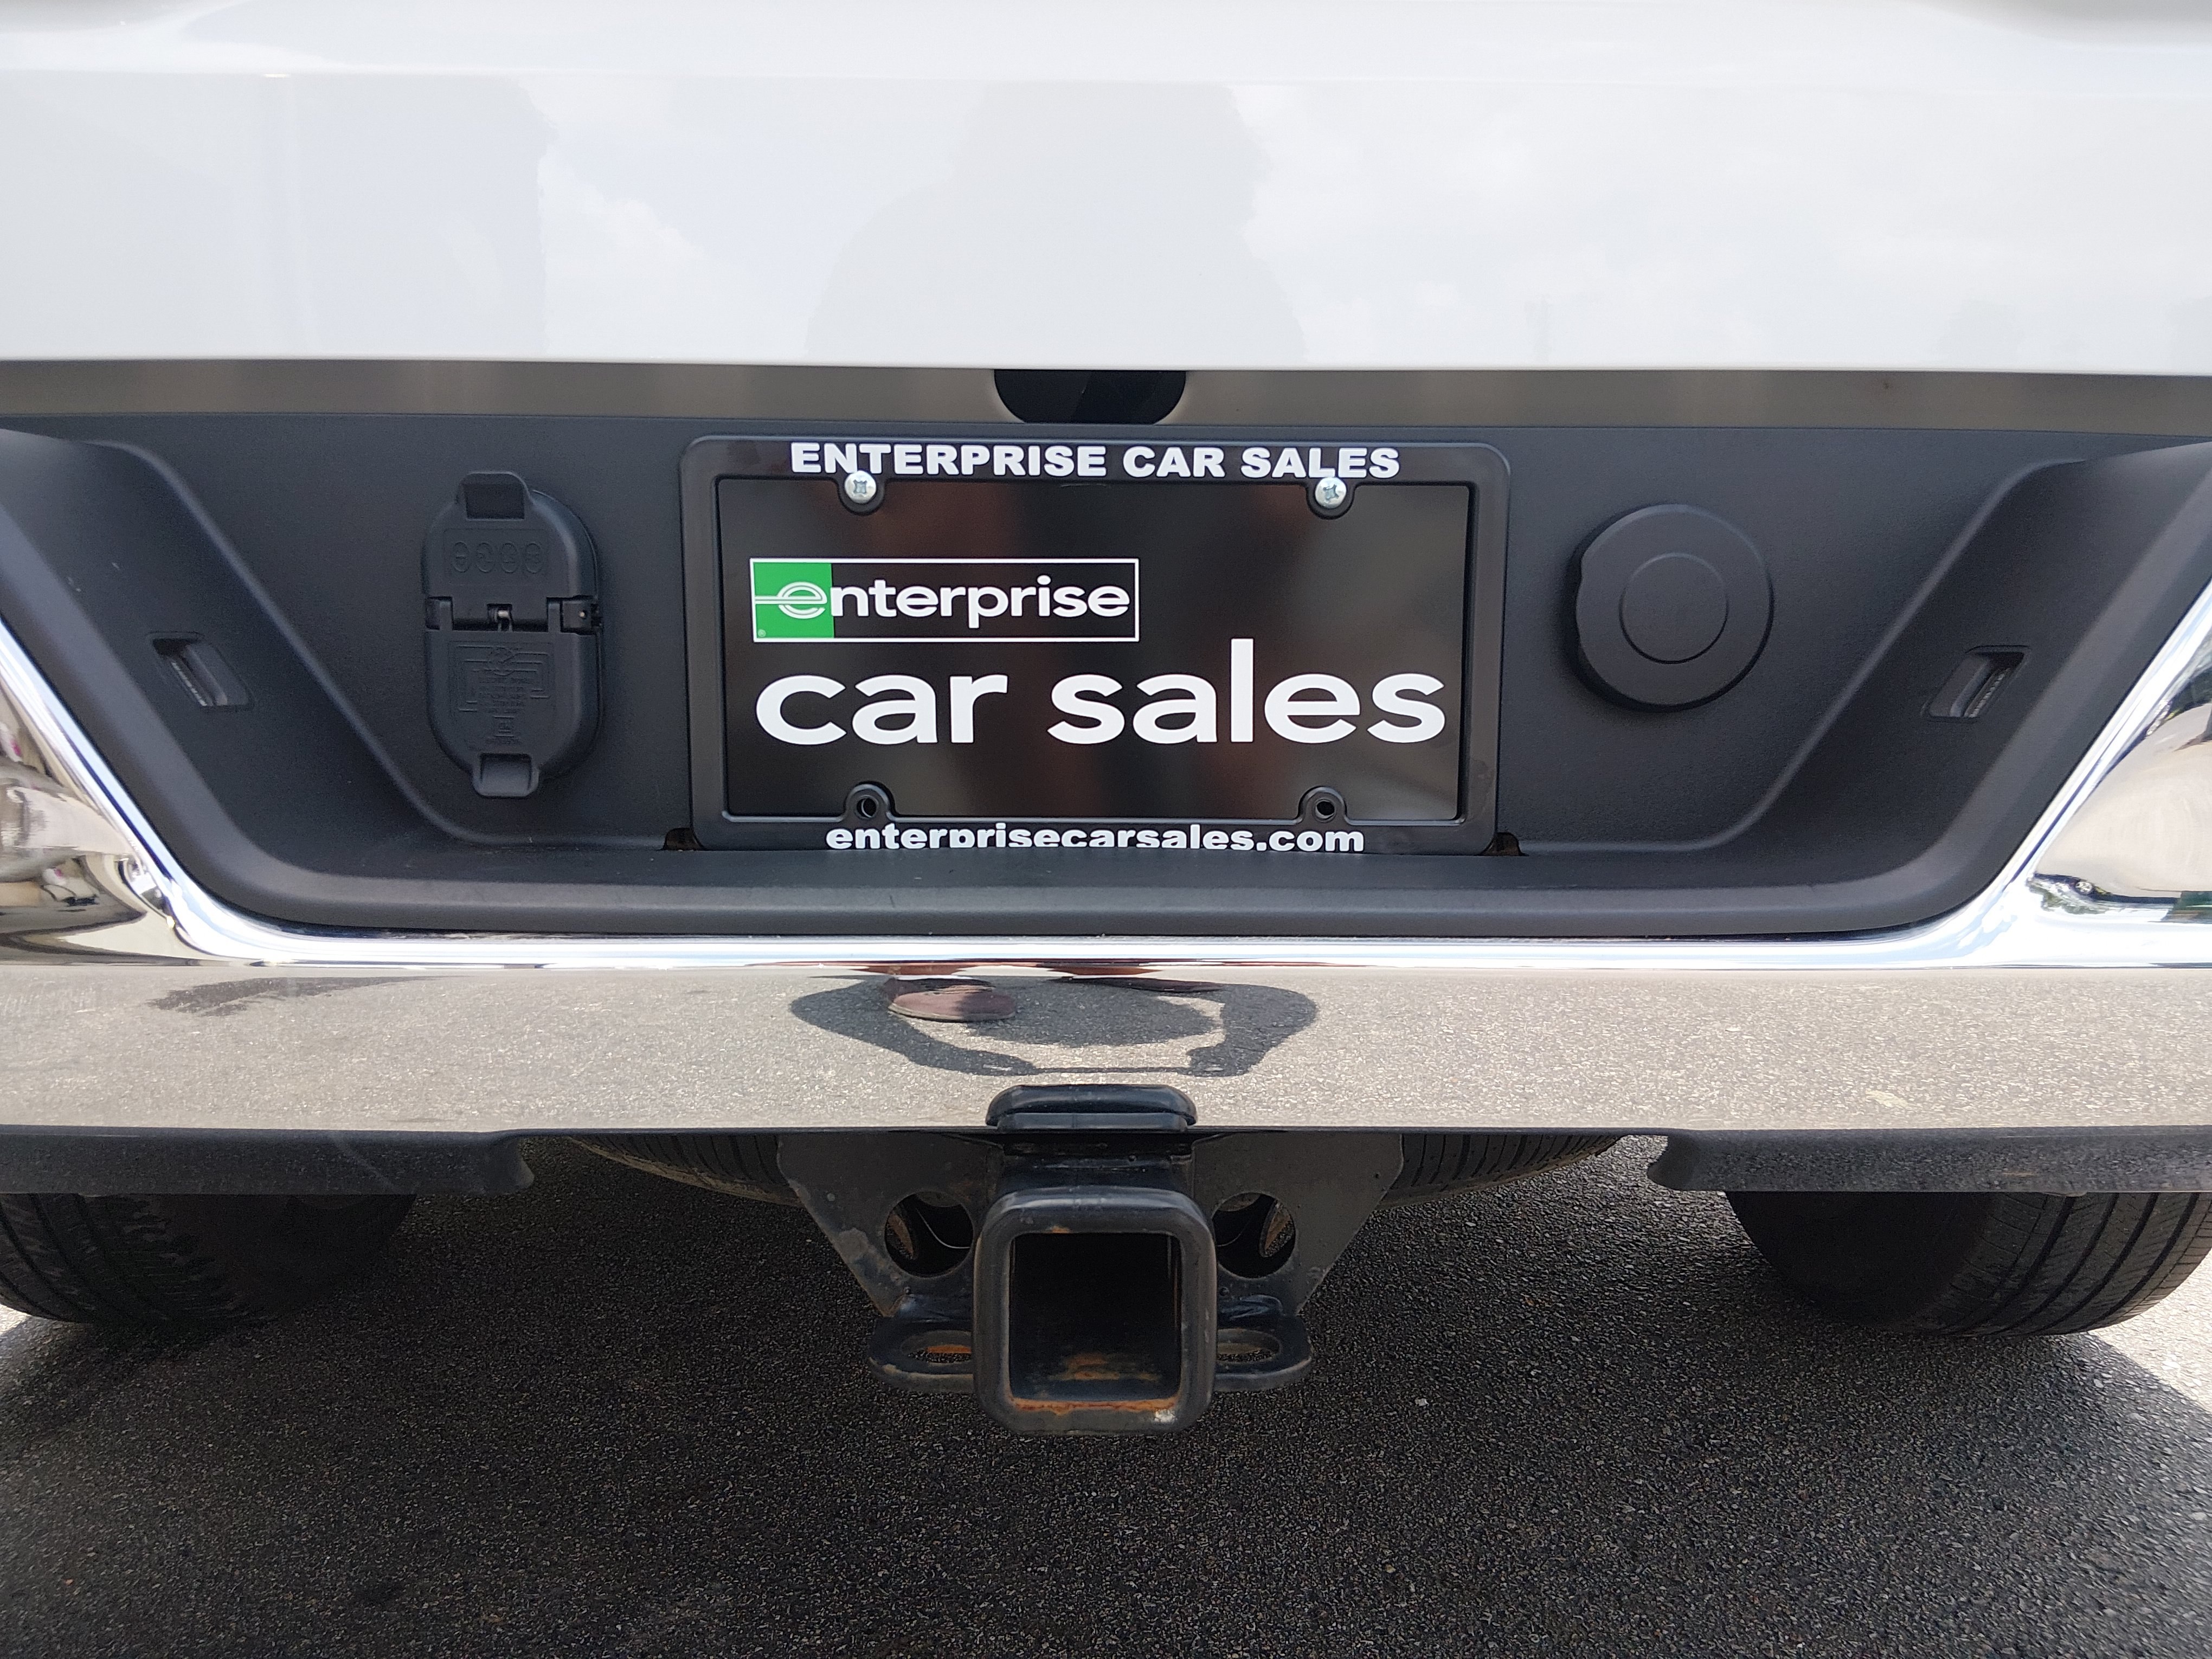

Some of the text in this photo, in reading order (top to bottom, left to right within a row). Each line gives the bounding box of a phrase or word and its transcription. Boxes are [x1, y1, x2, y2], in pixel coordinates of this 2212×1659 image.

[790, 441, 1400, 479] ENTERPRISE CAR SALES
[776, 575, 1130, 629] enterprise
[755, 638, 1446, 745] car sales
[825, 822, 1365, 853] enterprisecarsales.com
